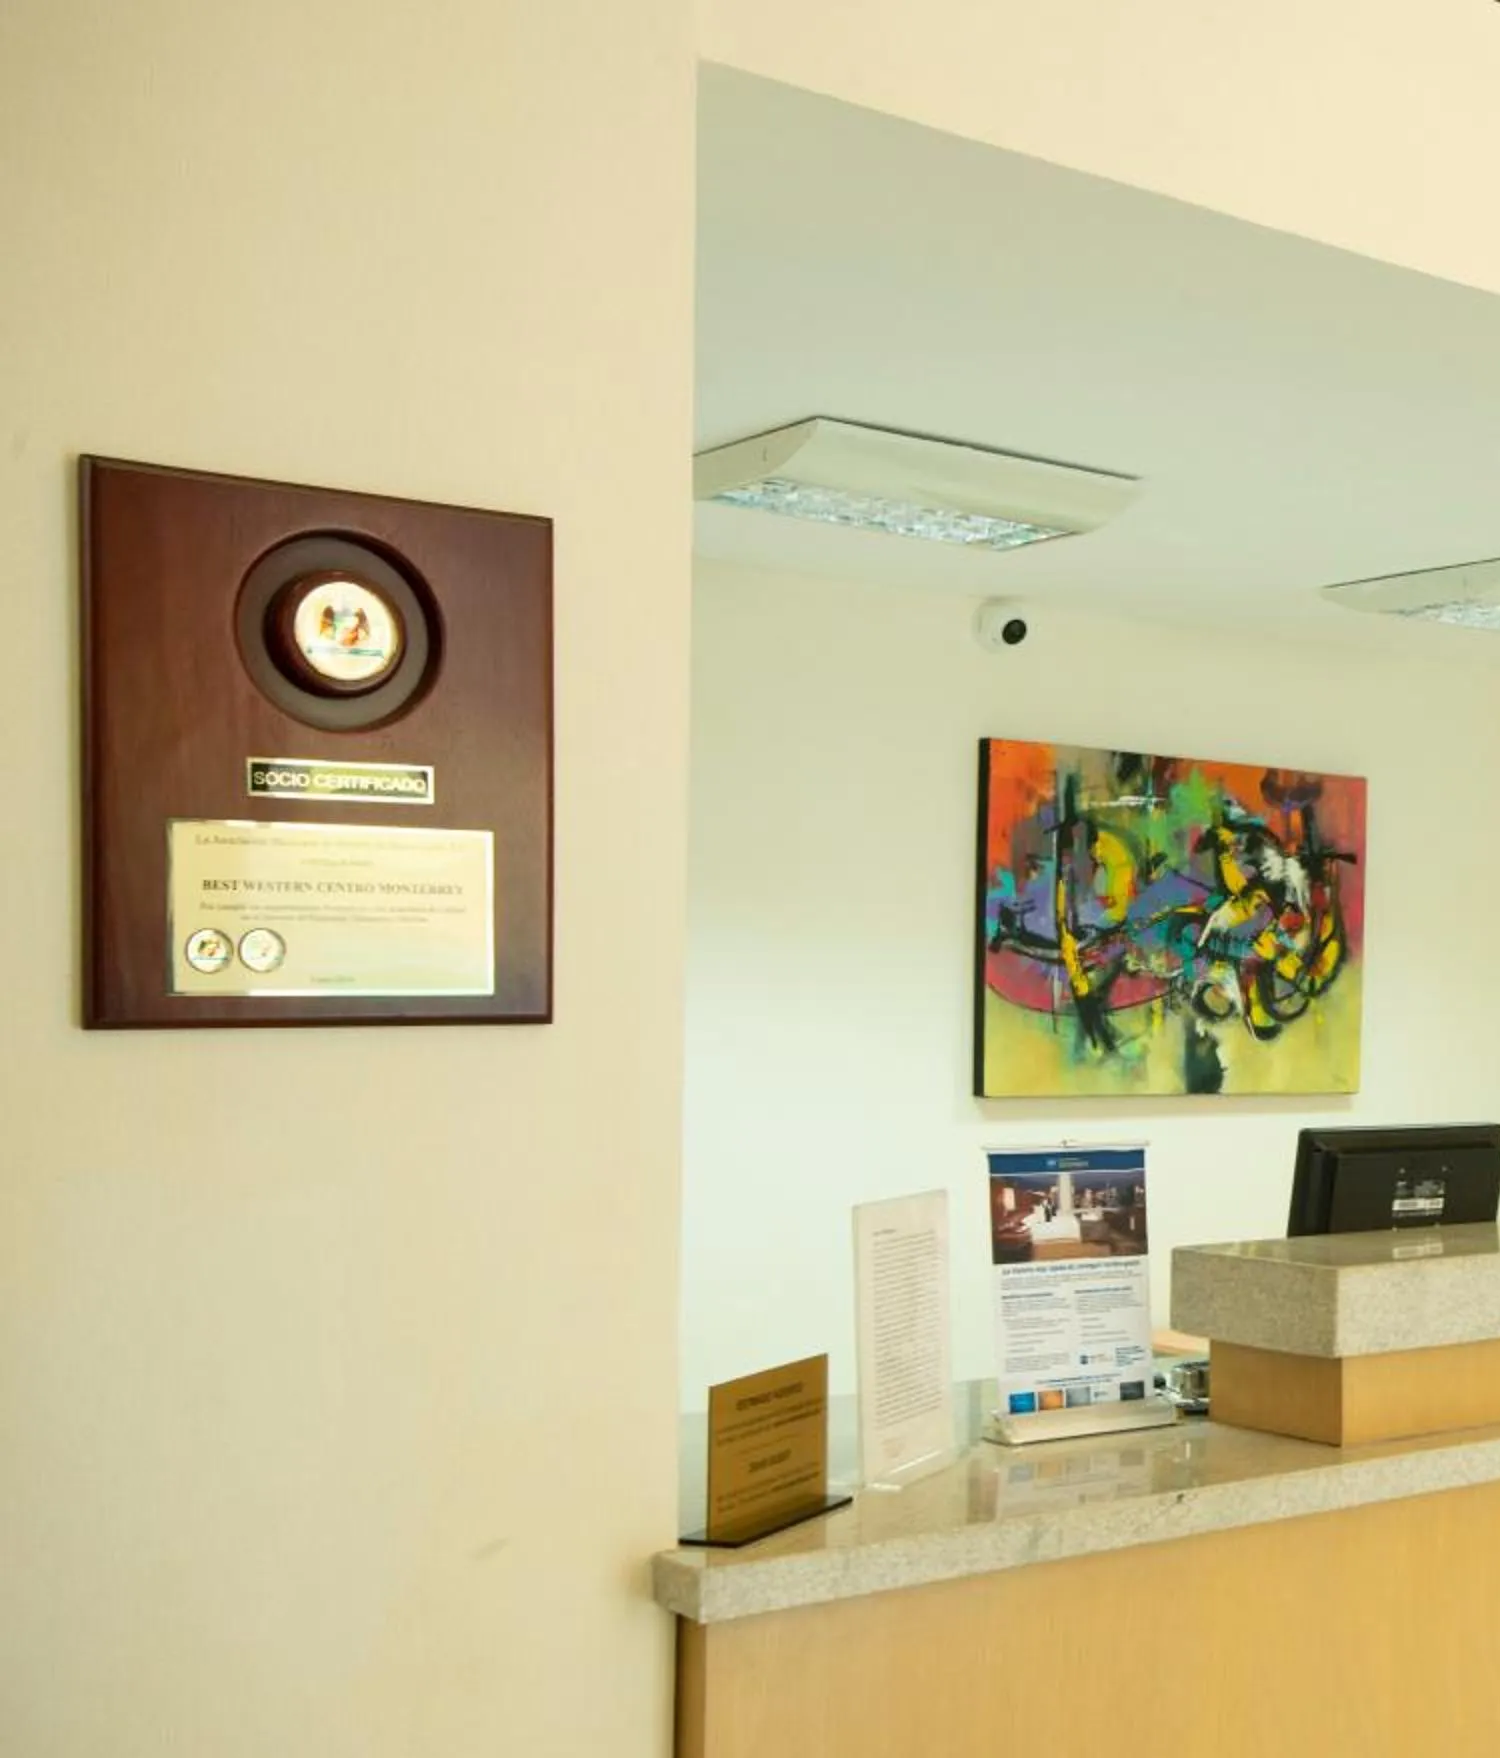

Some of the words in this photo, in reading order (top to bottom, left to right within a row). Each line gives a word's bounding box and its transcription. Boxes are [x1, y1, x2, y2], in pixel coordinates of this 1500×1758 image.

[253, 770, 310, 788] SOCIO
[312, 772, 427, 794] CERTIFICADO
[202, 878, 238, 891] BEST
[242, 880, 313, 893] WESTERN
[316, 881, 375, 894] CENTRO
[378, 882, 464, 896] MONTERREY
